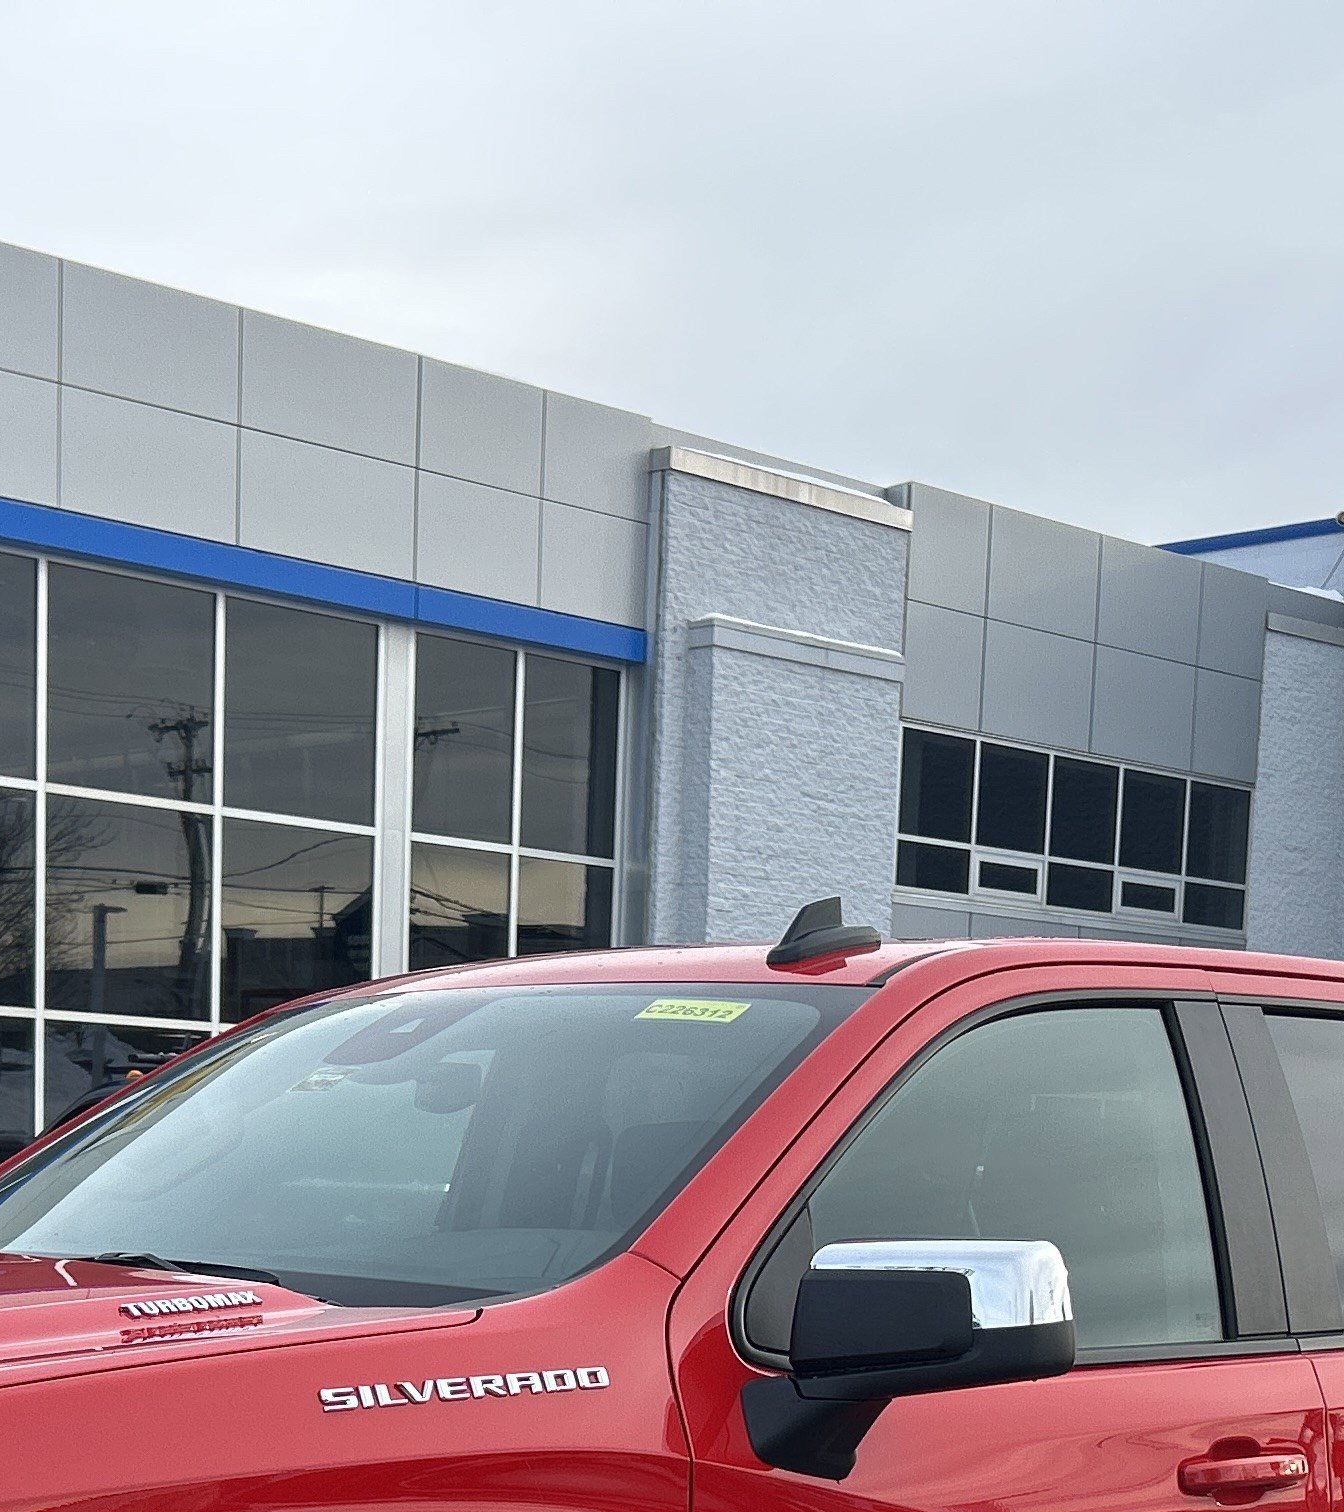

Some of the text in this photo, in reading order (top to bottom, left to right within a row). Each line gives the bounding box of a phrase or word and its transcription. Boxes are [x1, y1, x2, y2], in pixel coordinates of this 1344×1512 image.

[644, 1004, 734, 1019] C226312
[119, 1291, 263, 1319] TURBOMAX
[319, 1366, 610, 1412] SILVERADO
